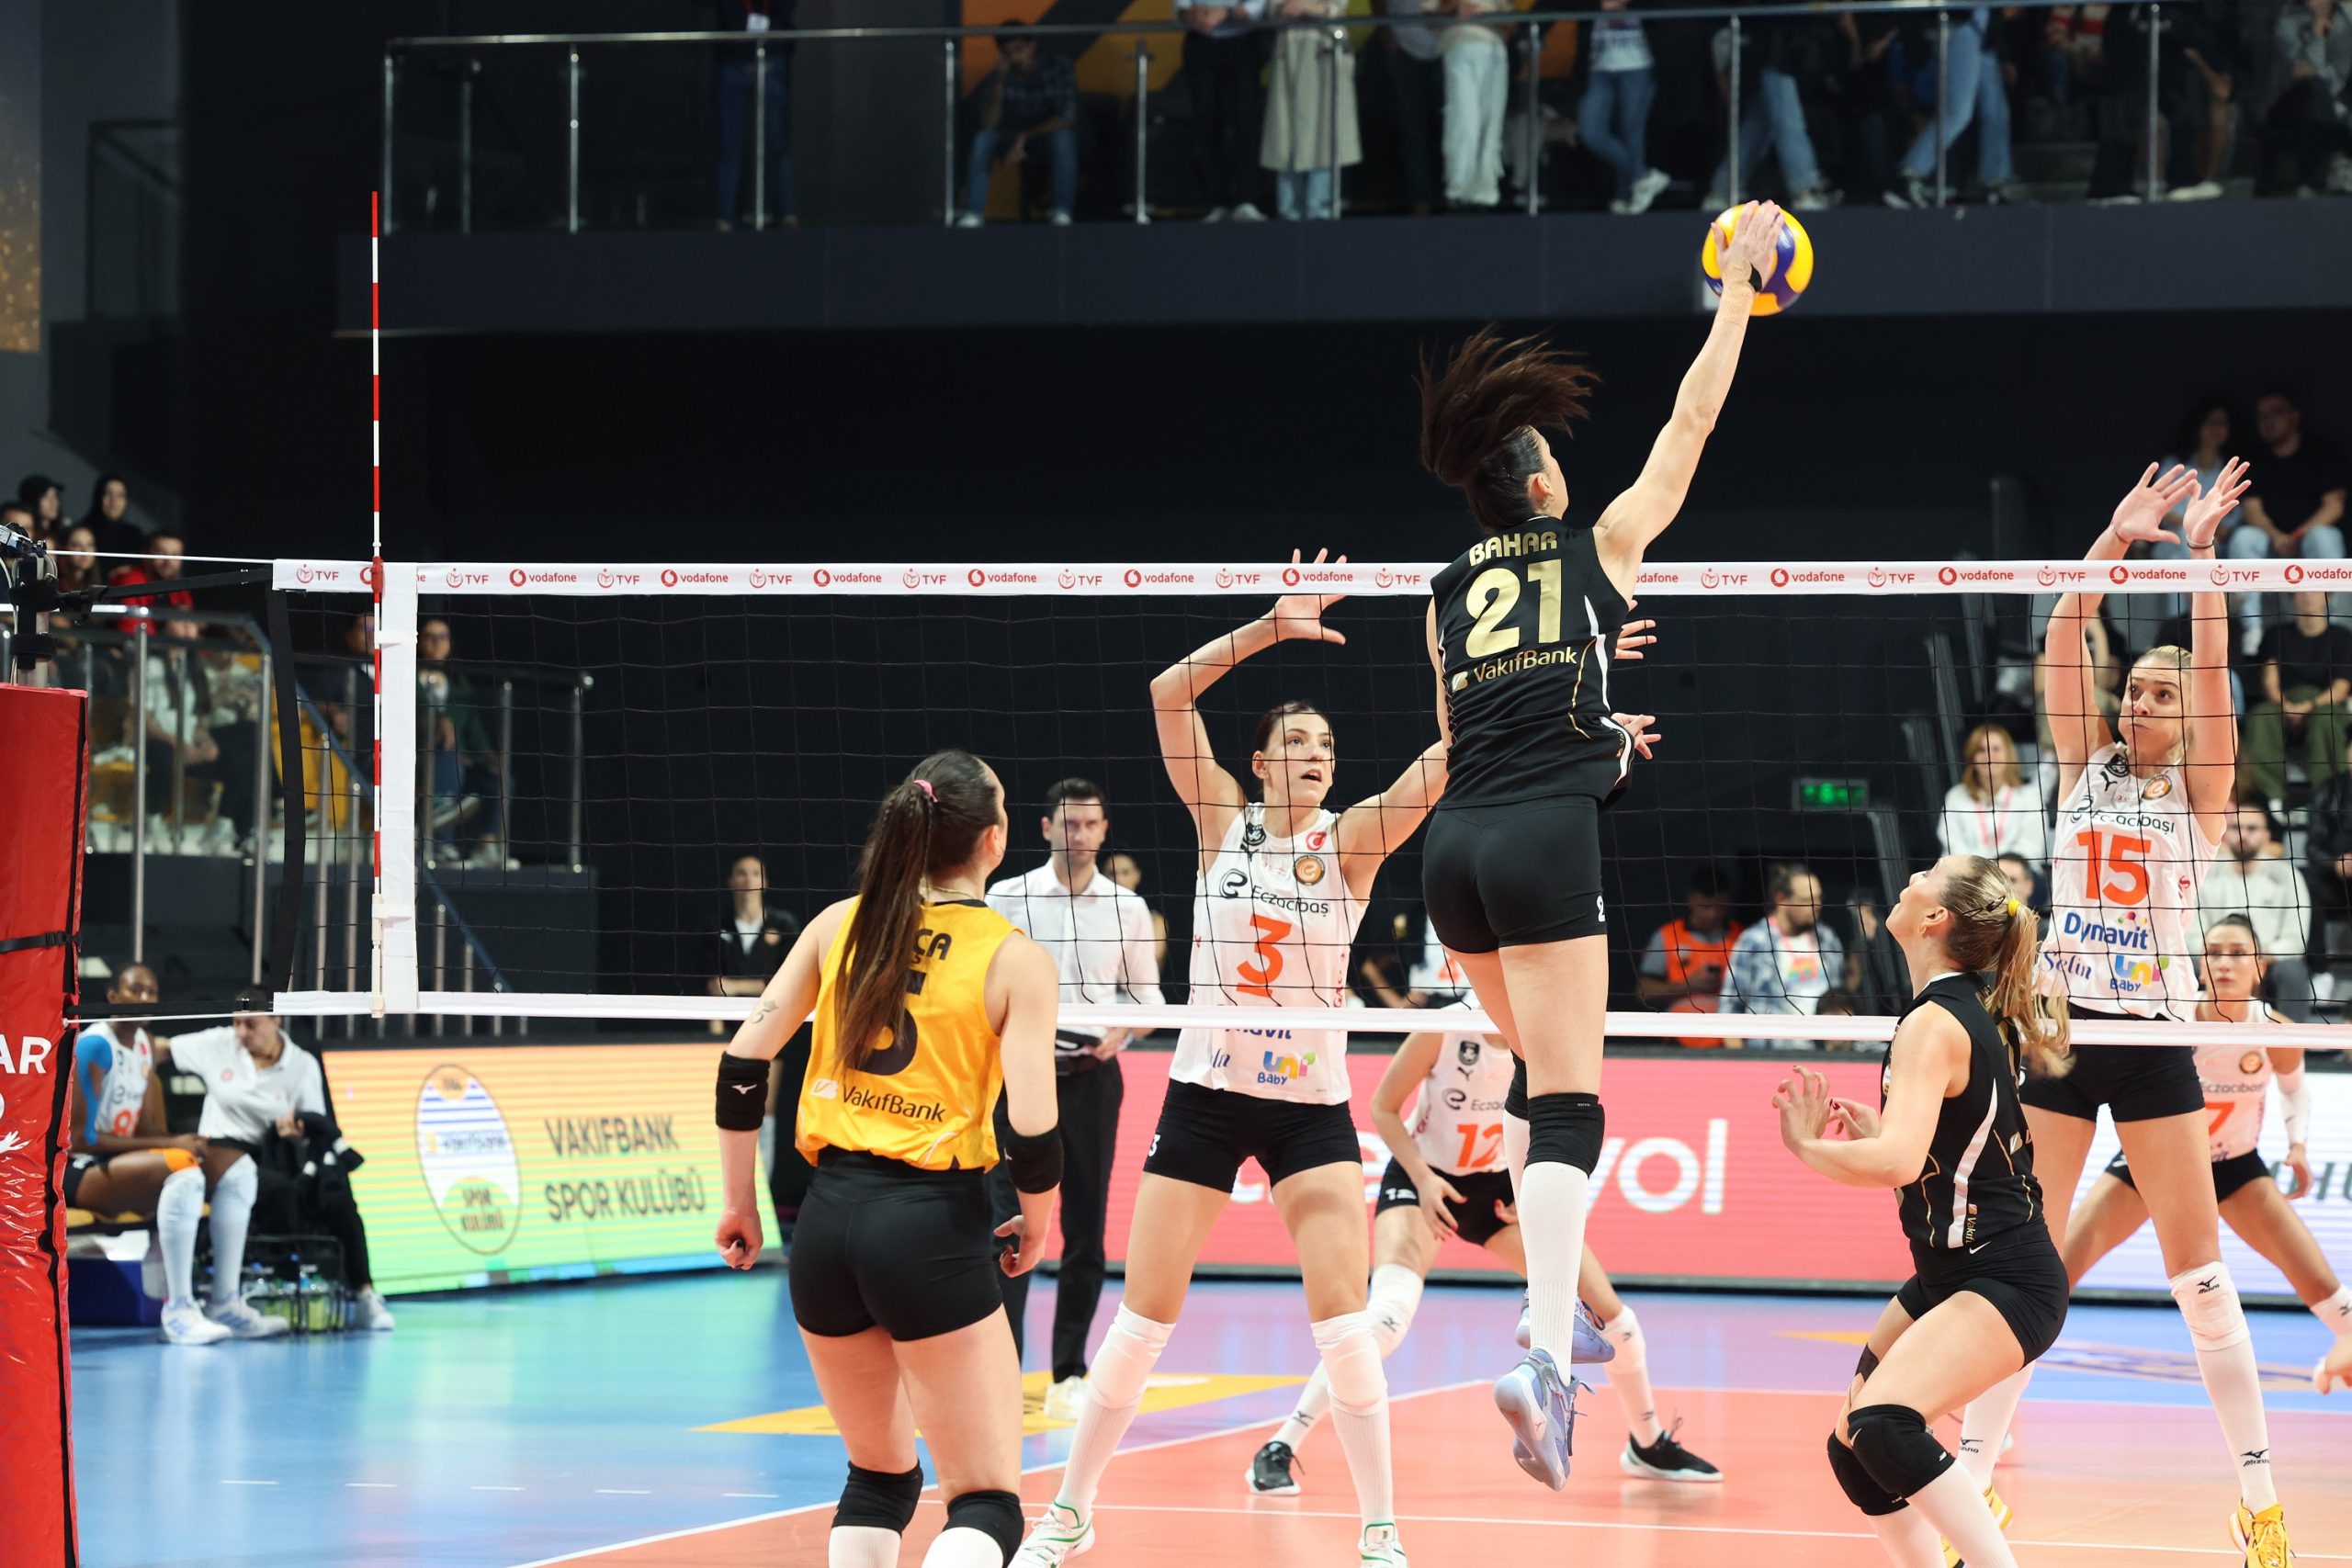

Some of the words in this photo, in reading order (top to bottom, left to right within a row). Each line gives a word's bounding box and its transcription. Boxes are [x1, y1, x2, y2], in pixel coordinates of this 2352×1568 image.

[1469, 531, 1557, 567] BAHAR
[315, 570, 339, 581] TVF
[466, 574, 489, 584] TVF
[529, 573, 577, 583] vodafone
[616, 574, 640, 584] TVF
[680, 573, 729, 583] vodafone
[768, 574, 792, 584] TVF
[833, 573, 882, 583] vodafone
[922, 574, 946, 585] TVF
[988, 573, 1037, 583] vodafone
[1078, 575, 1102, 585] TVF
[1145, 573, 1194, 583] vodafone
[1236, 574, 1261, 585] TVF
[1303, 572, 1353, 582] vodafone
[1396, 574, 1420, 585] TVF
[1636, 572, 1679, 583] dafone
[1722, 575, 1747, 585] TVF
[1792, 572, 1845, 582] vodafone
[1889, 573, 1915, 584] TVF
[1960, 570, 2014, 581] vodafone
[2059, 571, 2086, 582] TVF
[2132, 569, 2187, 580] vodafone
[2233, 571, 2260, 581] TVF
[1465, 558, 1561, 659] 21
[1474, 646, 1577, 682] VakıfBank
[2092, 809, 2175, 835] Ecacıbaşı
[2076, 830, 2152, 906] 15
[1251, 885, 1329, 918] Eczacıbaş
[2064, 911, 2149, 950] Dynavit
[1237, 913, 1293, 986] 3
[1257, 1071, 1288, 1085] Baby
[842, 1086, 946, 1122] VakıfBank
[545, 1115, 680, 1156] VAKIFBANK
[1455, 1122, 1504, 1168] 12
[545, 1181, 614, 1222] SPOR
[616, 1167, 707, 1218] KULÜBÜ
